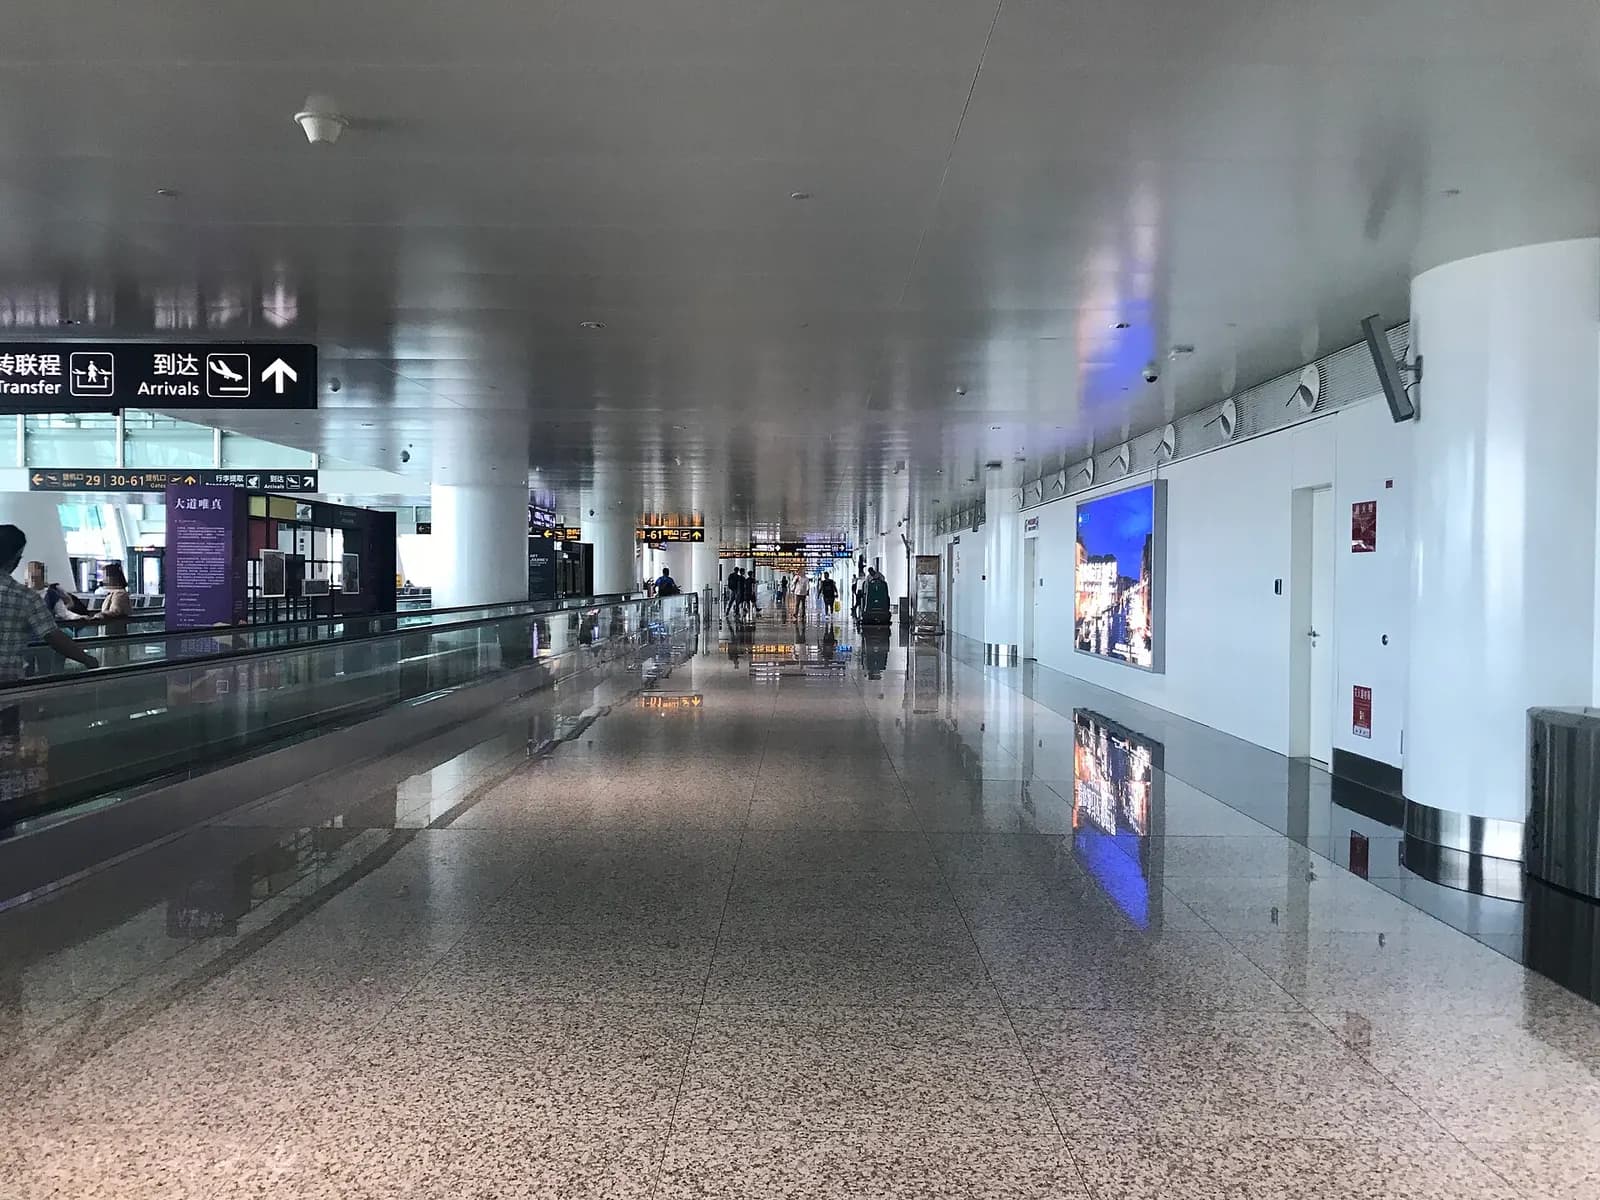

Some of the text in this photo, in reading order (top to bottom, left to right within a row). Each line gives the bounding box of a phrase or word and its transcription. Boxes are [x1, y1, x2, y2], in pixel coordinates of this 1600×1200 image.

[153, 353, 200, 376] 到达
[138, 381, 200, 396] Arrivals
[85, 475, 101, 486] 29
[110, 475, 144, 486] 30-61
